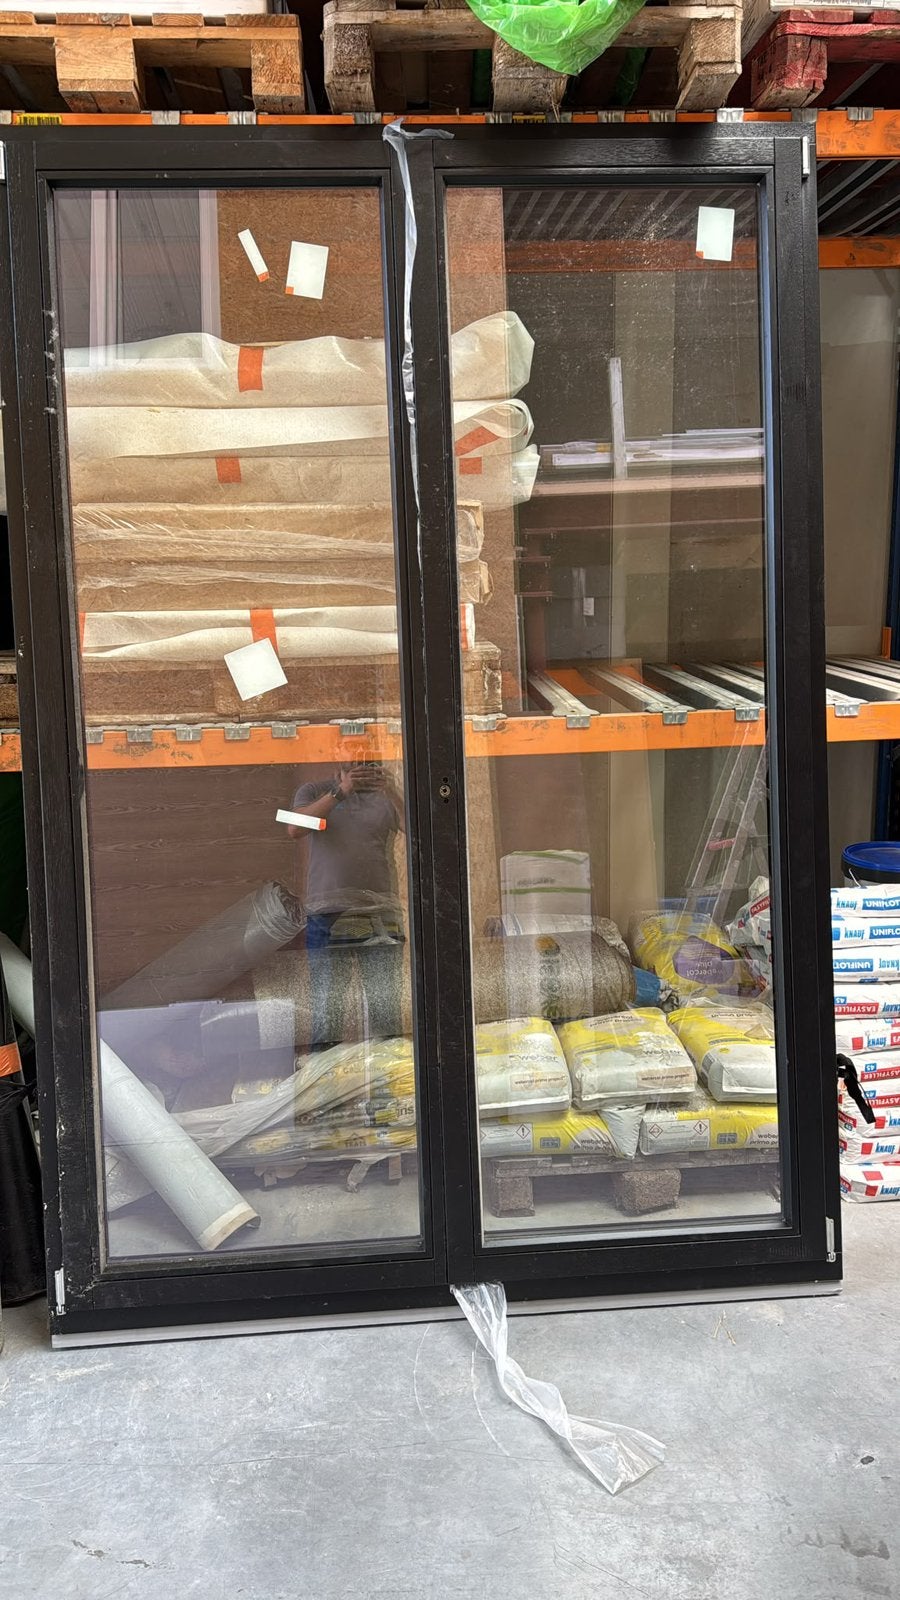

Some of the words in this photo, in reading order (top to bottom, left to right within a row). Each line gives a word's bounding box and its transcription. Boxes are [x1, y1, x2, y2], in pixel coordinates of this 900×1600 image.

[836, 898, 858, 910] KNAUF
[865, 899, 900, 907] UNIFLOT
[844, 927, 865, 940] KNAUF
[833, 961, 871, 970] UNIFLOT
[867, 1034, 887, 1047] KNAUF
[875, 1142, 896, 1155] KNAUF
[879, 1185, 900, 1197] KNAUF
